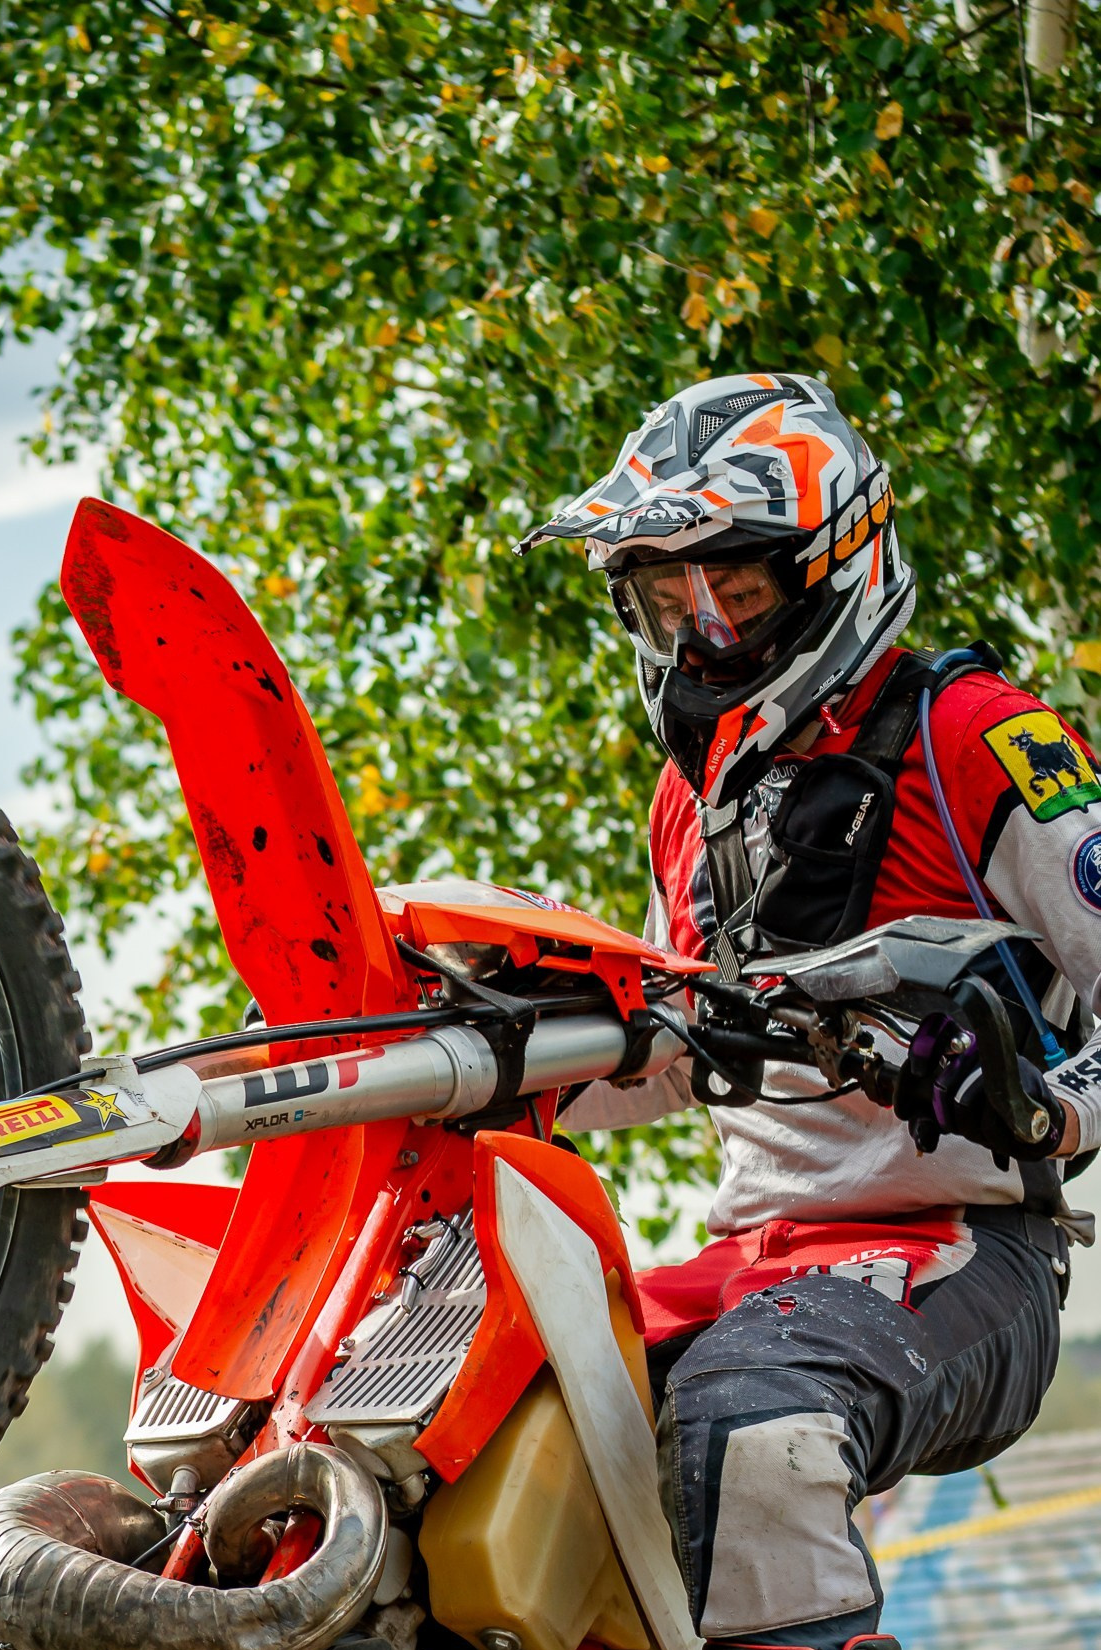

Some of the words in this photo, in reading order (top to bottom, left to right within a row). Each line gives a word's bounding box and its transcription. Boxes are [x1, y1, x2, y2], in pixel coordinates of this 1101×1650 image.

[795, 469, 895, 589] 100
[708, 738, 728, 774] AIROH
[844, 792, 875, 847] E-GEAR
[244, 1112, 290, 1132] XPLOR
